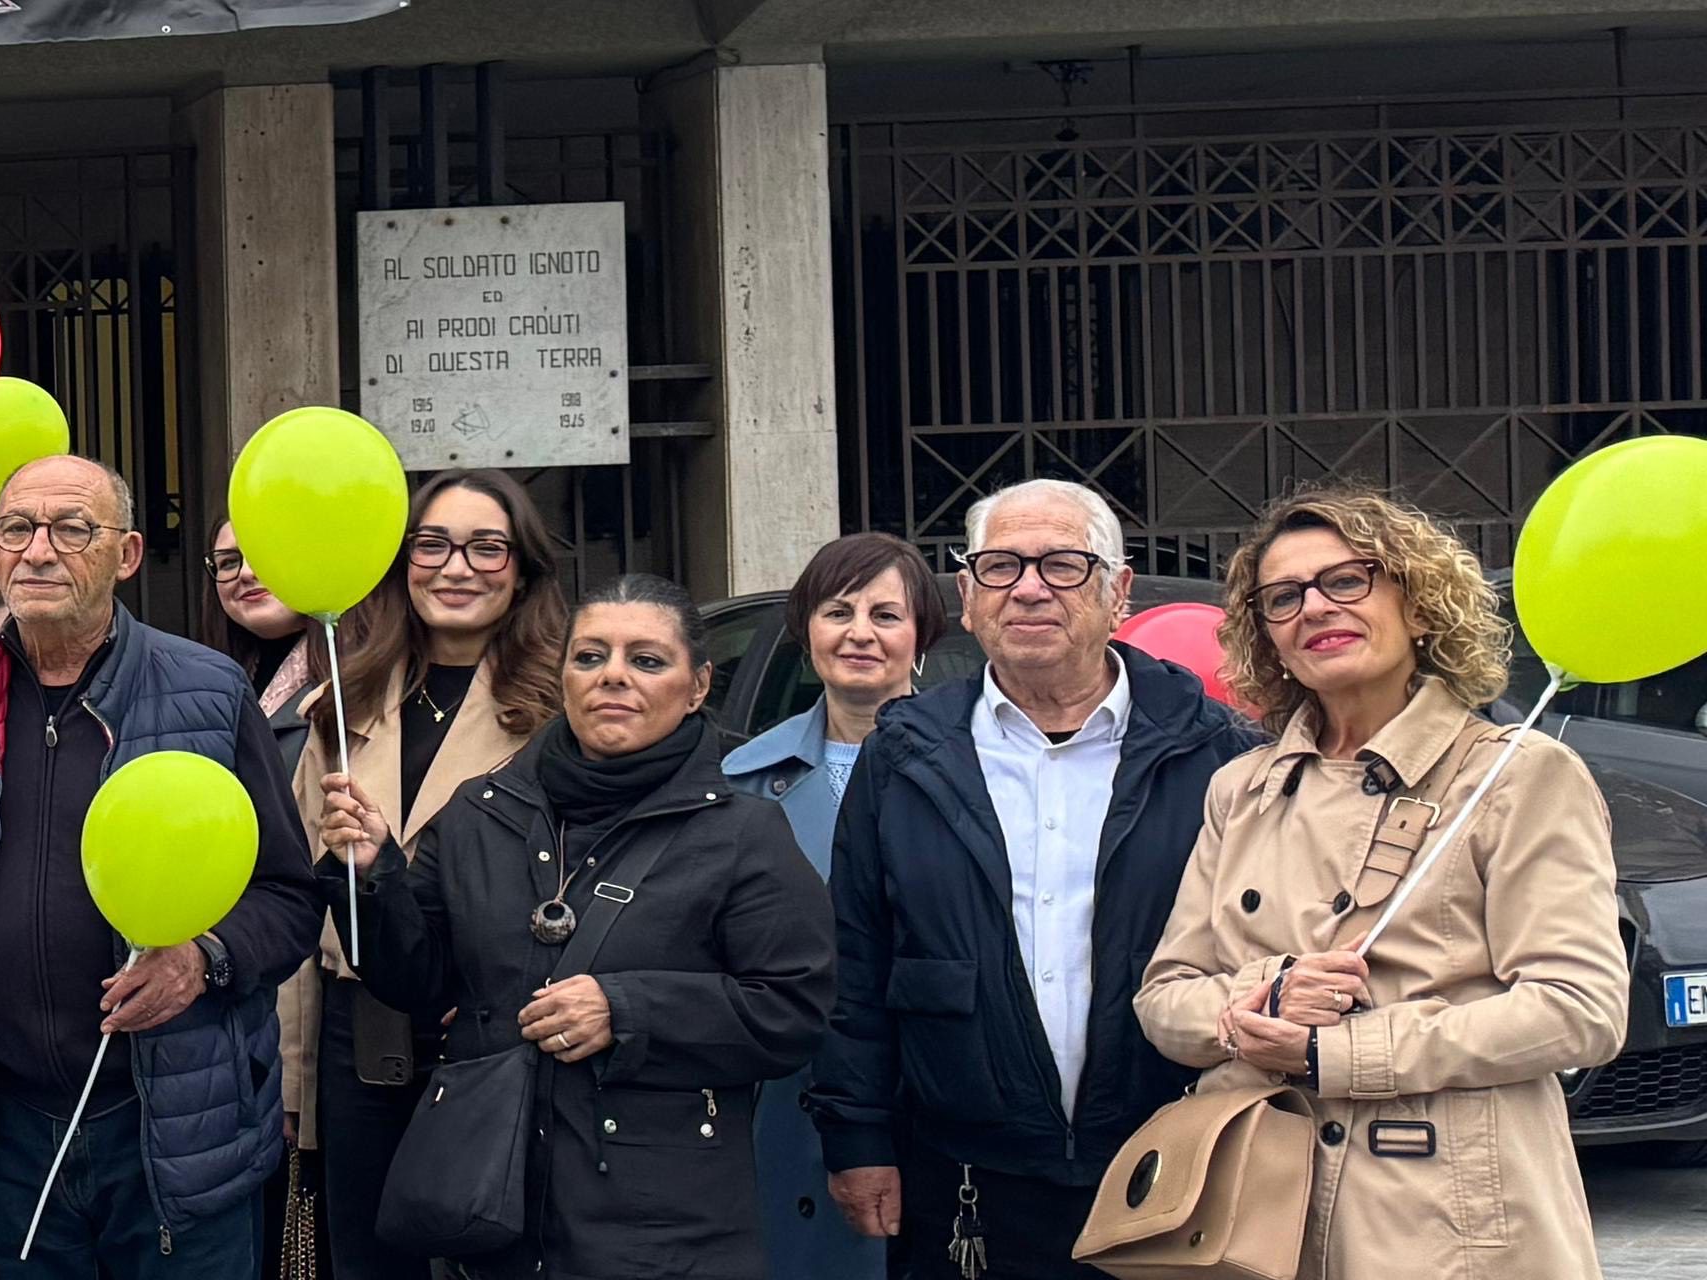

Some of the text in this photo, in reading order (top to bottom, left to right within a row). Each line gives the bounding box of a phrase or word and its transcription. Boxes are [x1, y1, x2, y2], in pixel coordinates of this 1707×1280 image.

[384, 250, 600, 280] AL SOLDATO IGNOTO
[482, 291, 503, 303] ED
[406, 314, 580, 339] AI PRODI CADUTI
[386, 347, 601, 374] DI QUESTA TERRA
